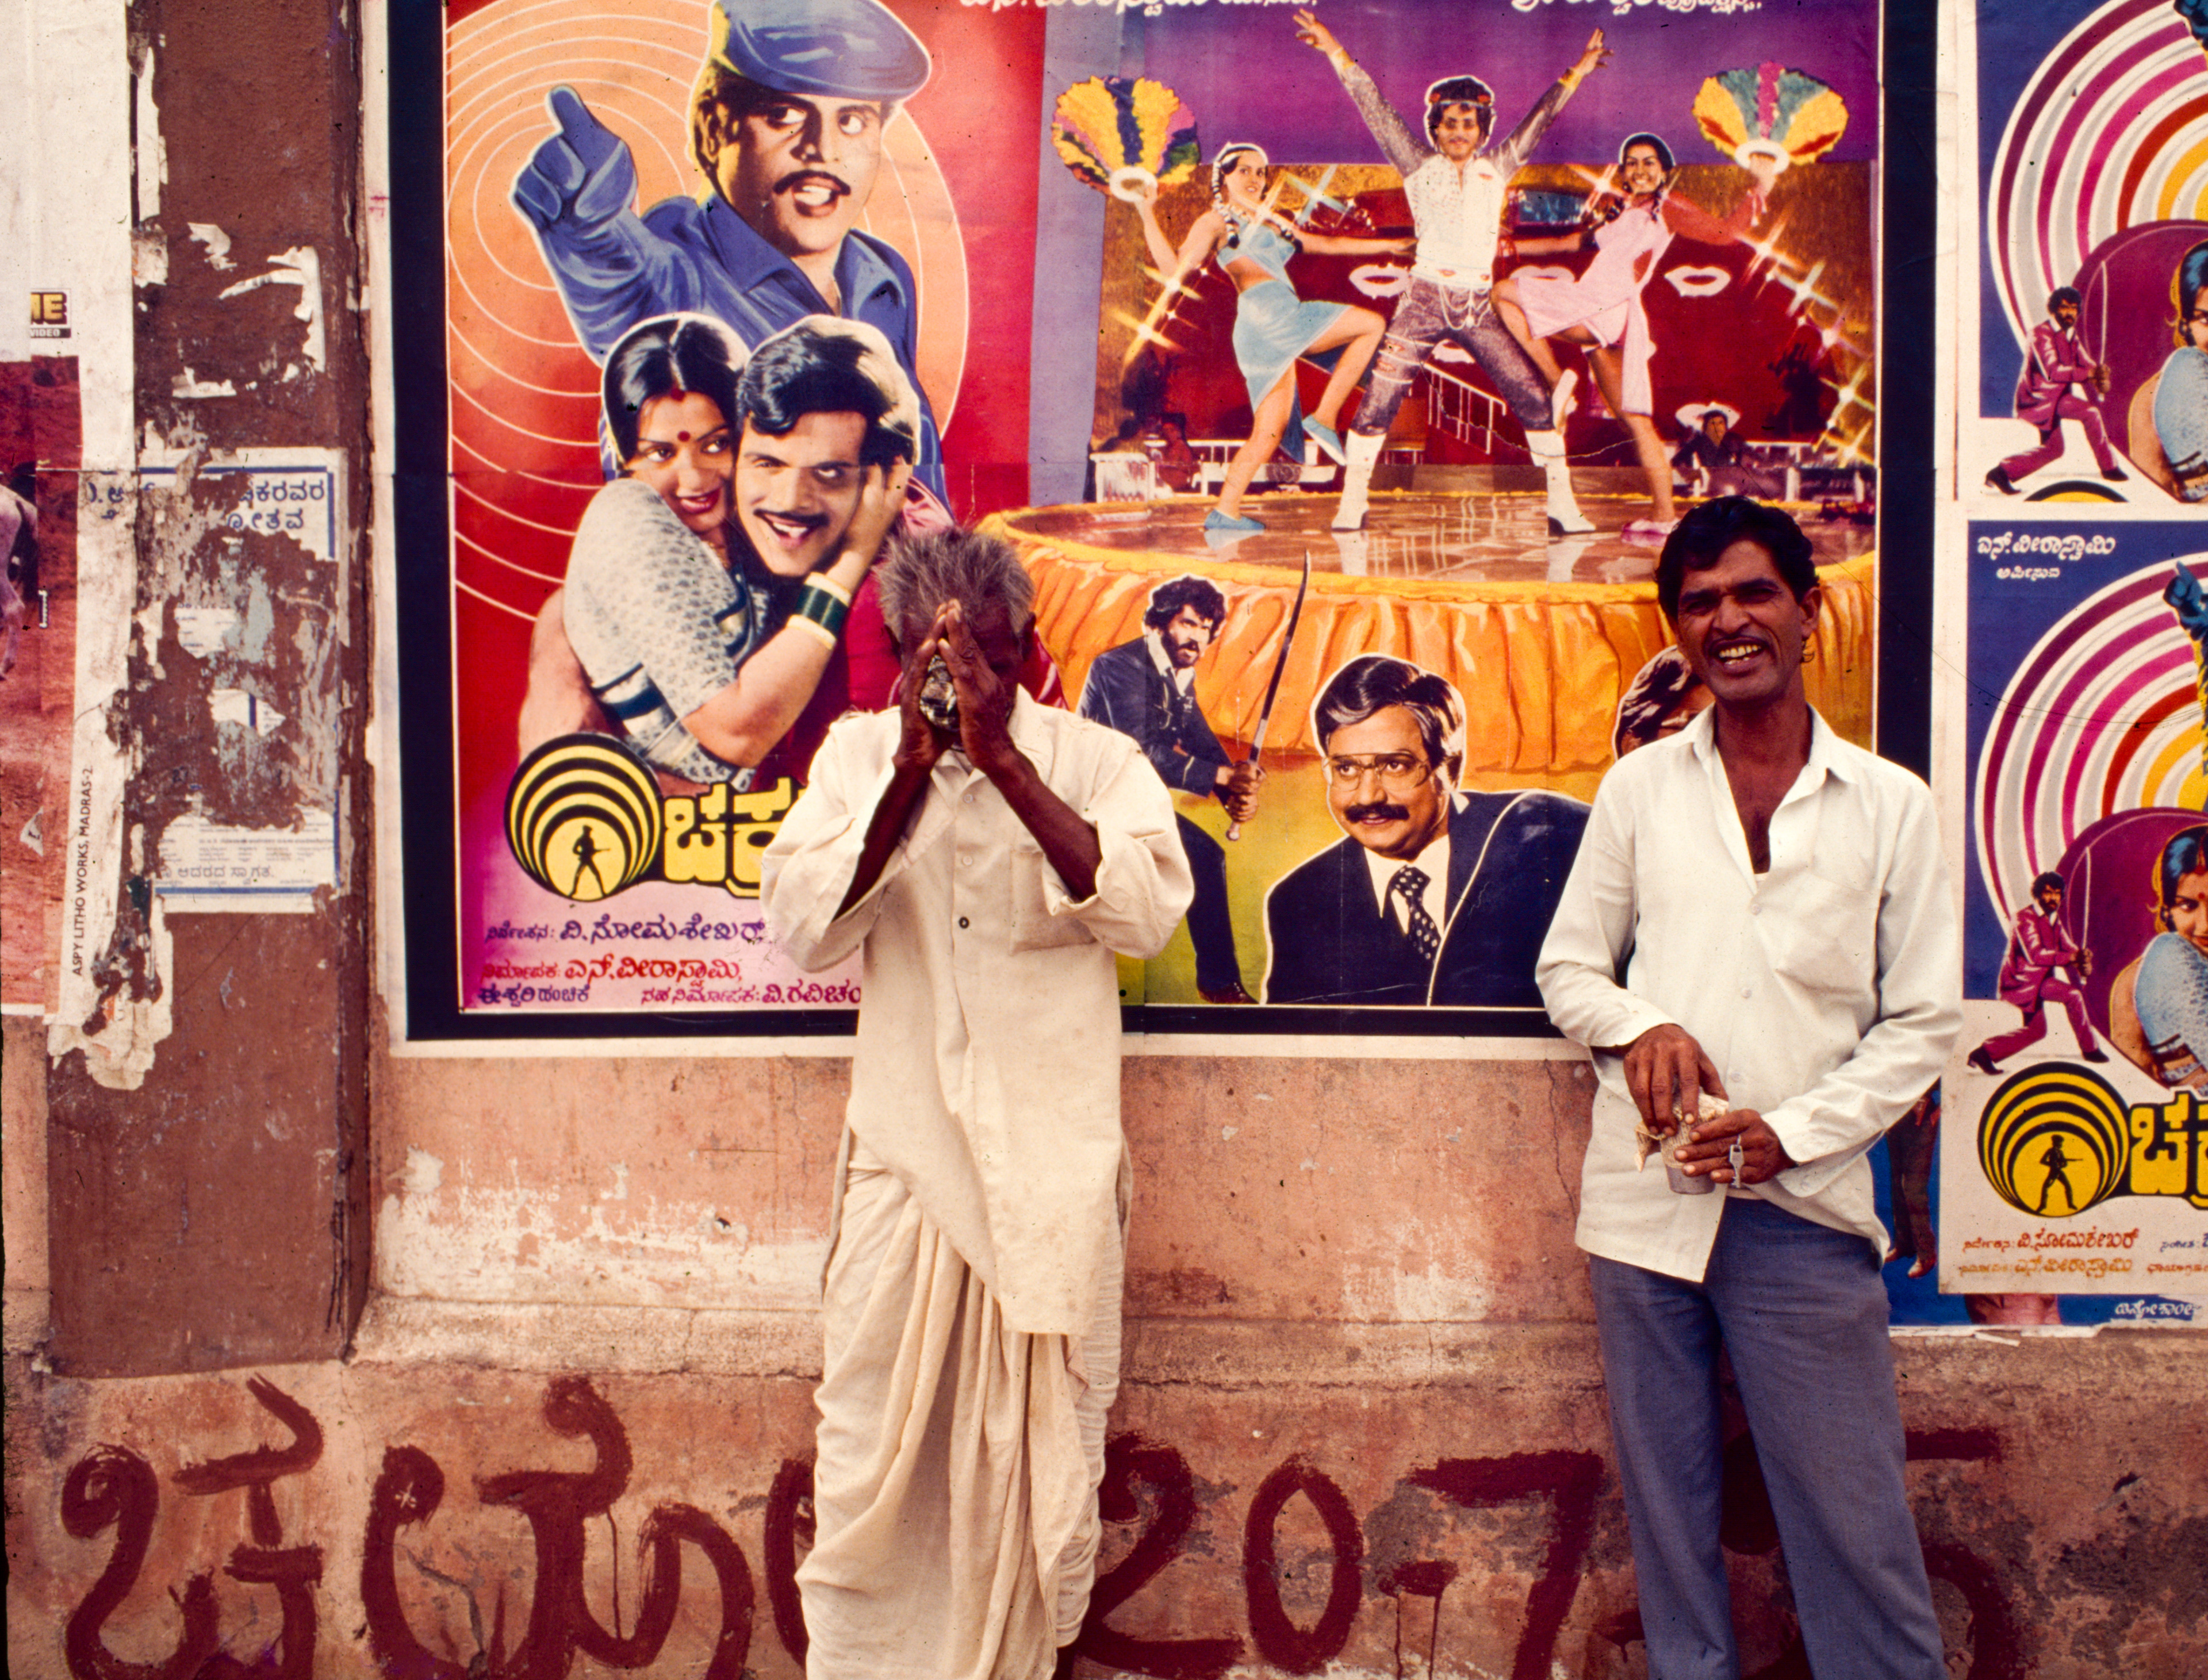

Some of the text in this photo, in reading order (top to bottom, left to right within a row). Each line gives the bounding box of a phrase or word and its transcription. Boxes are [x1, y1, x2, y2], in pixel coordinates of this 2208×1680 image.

[77, 841, 90, 895] WORKS,
[74, 897, 86, 938] LITHO
[71, 940, 84, 976] ASPY
